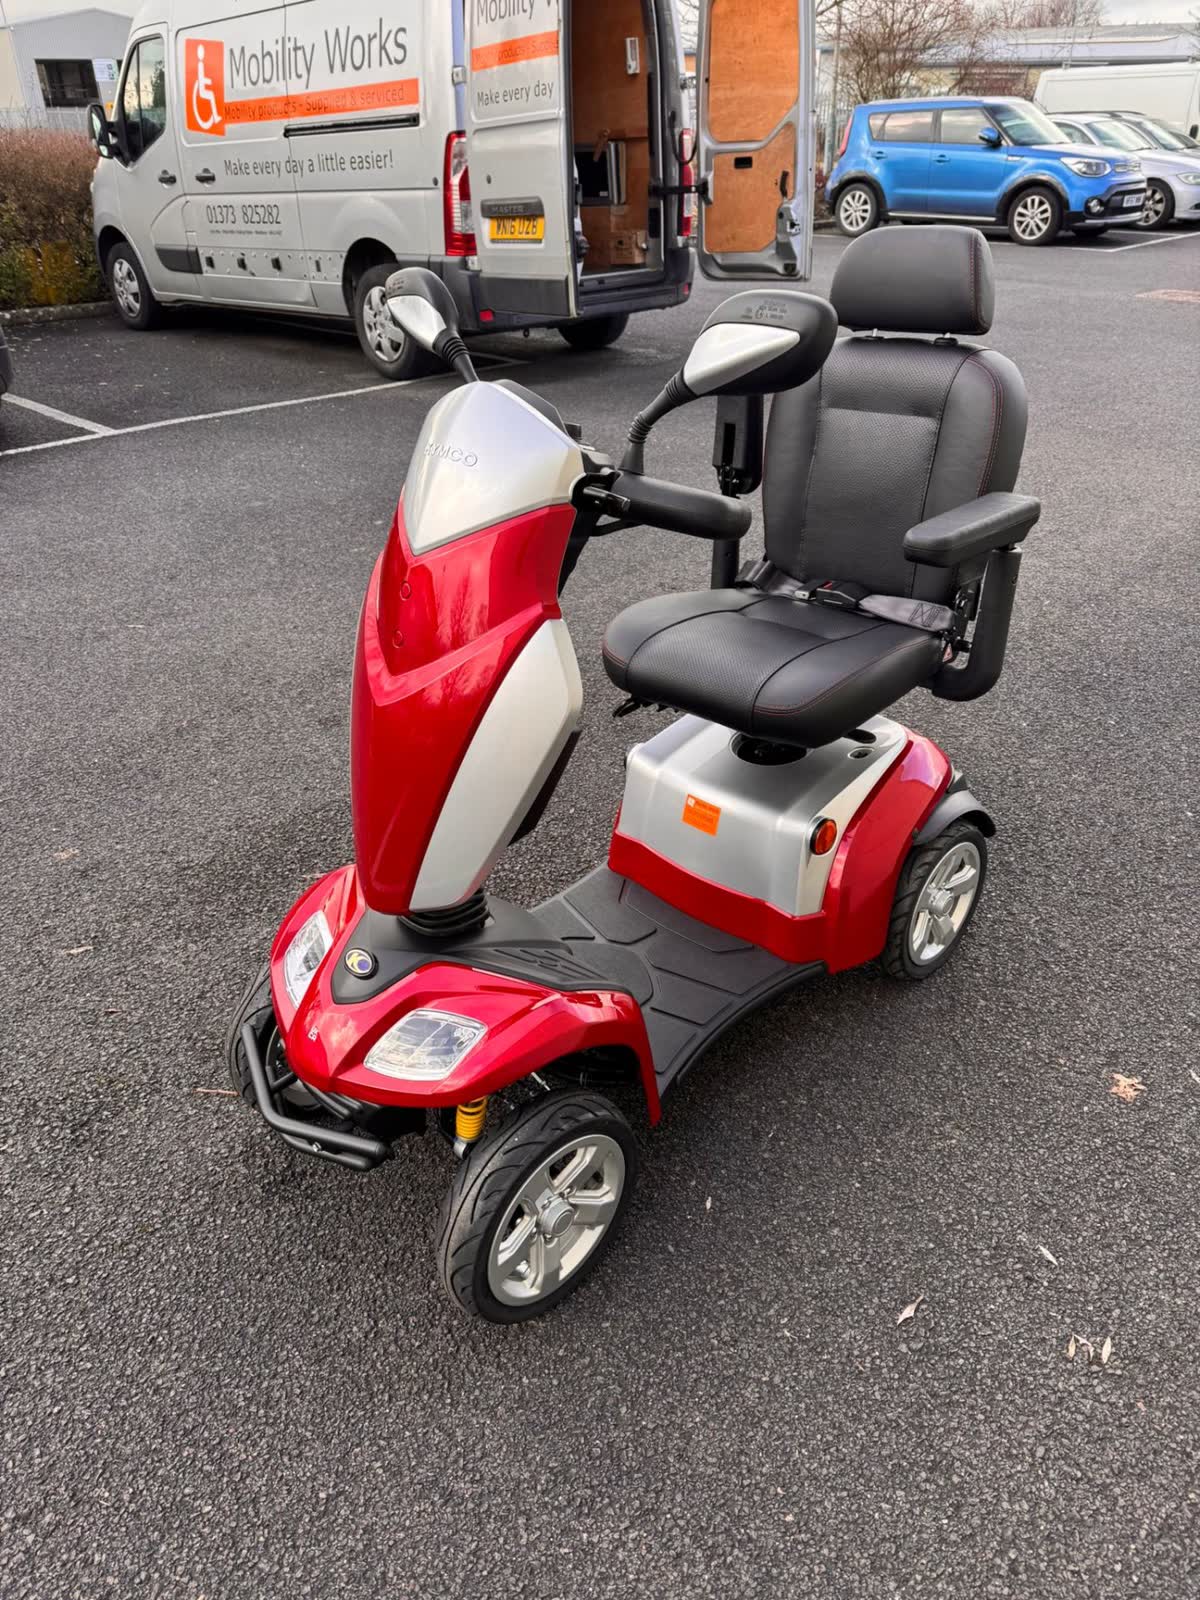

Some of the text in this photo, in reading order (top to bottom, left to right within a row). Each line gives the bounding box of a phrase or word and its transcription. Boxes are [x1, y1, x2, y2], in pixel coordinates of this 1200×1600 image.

[229, 17, 407, 90] Mobility Works
[258, 99, 297, 120] products
[360, 85, 405, 106] serviced
[477, 79, 554, 106] Make every day
[224, 149, 394, 179] Make every day a little easier!
[206, 204, 282, 225] 01373 825282
